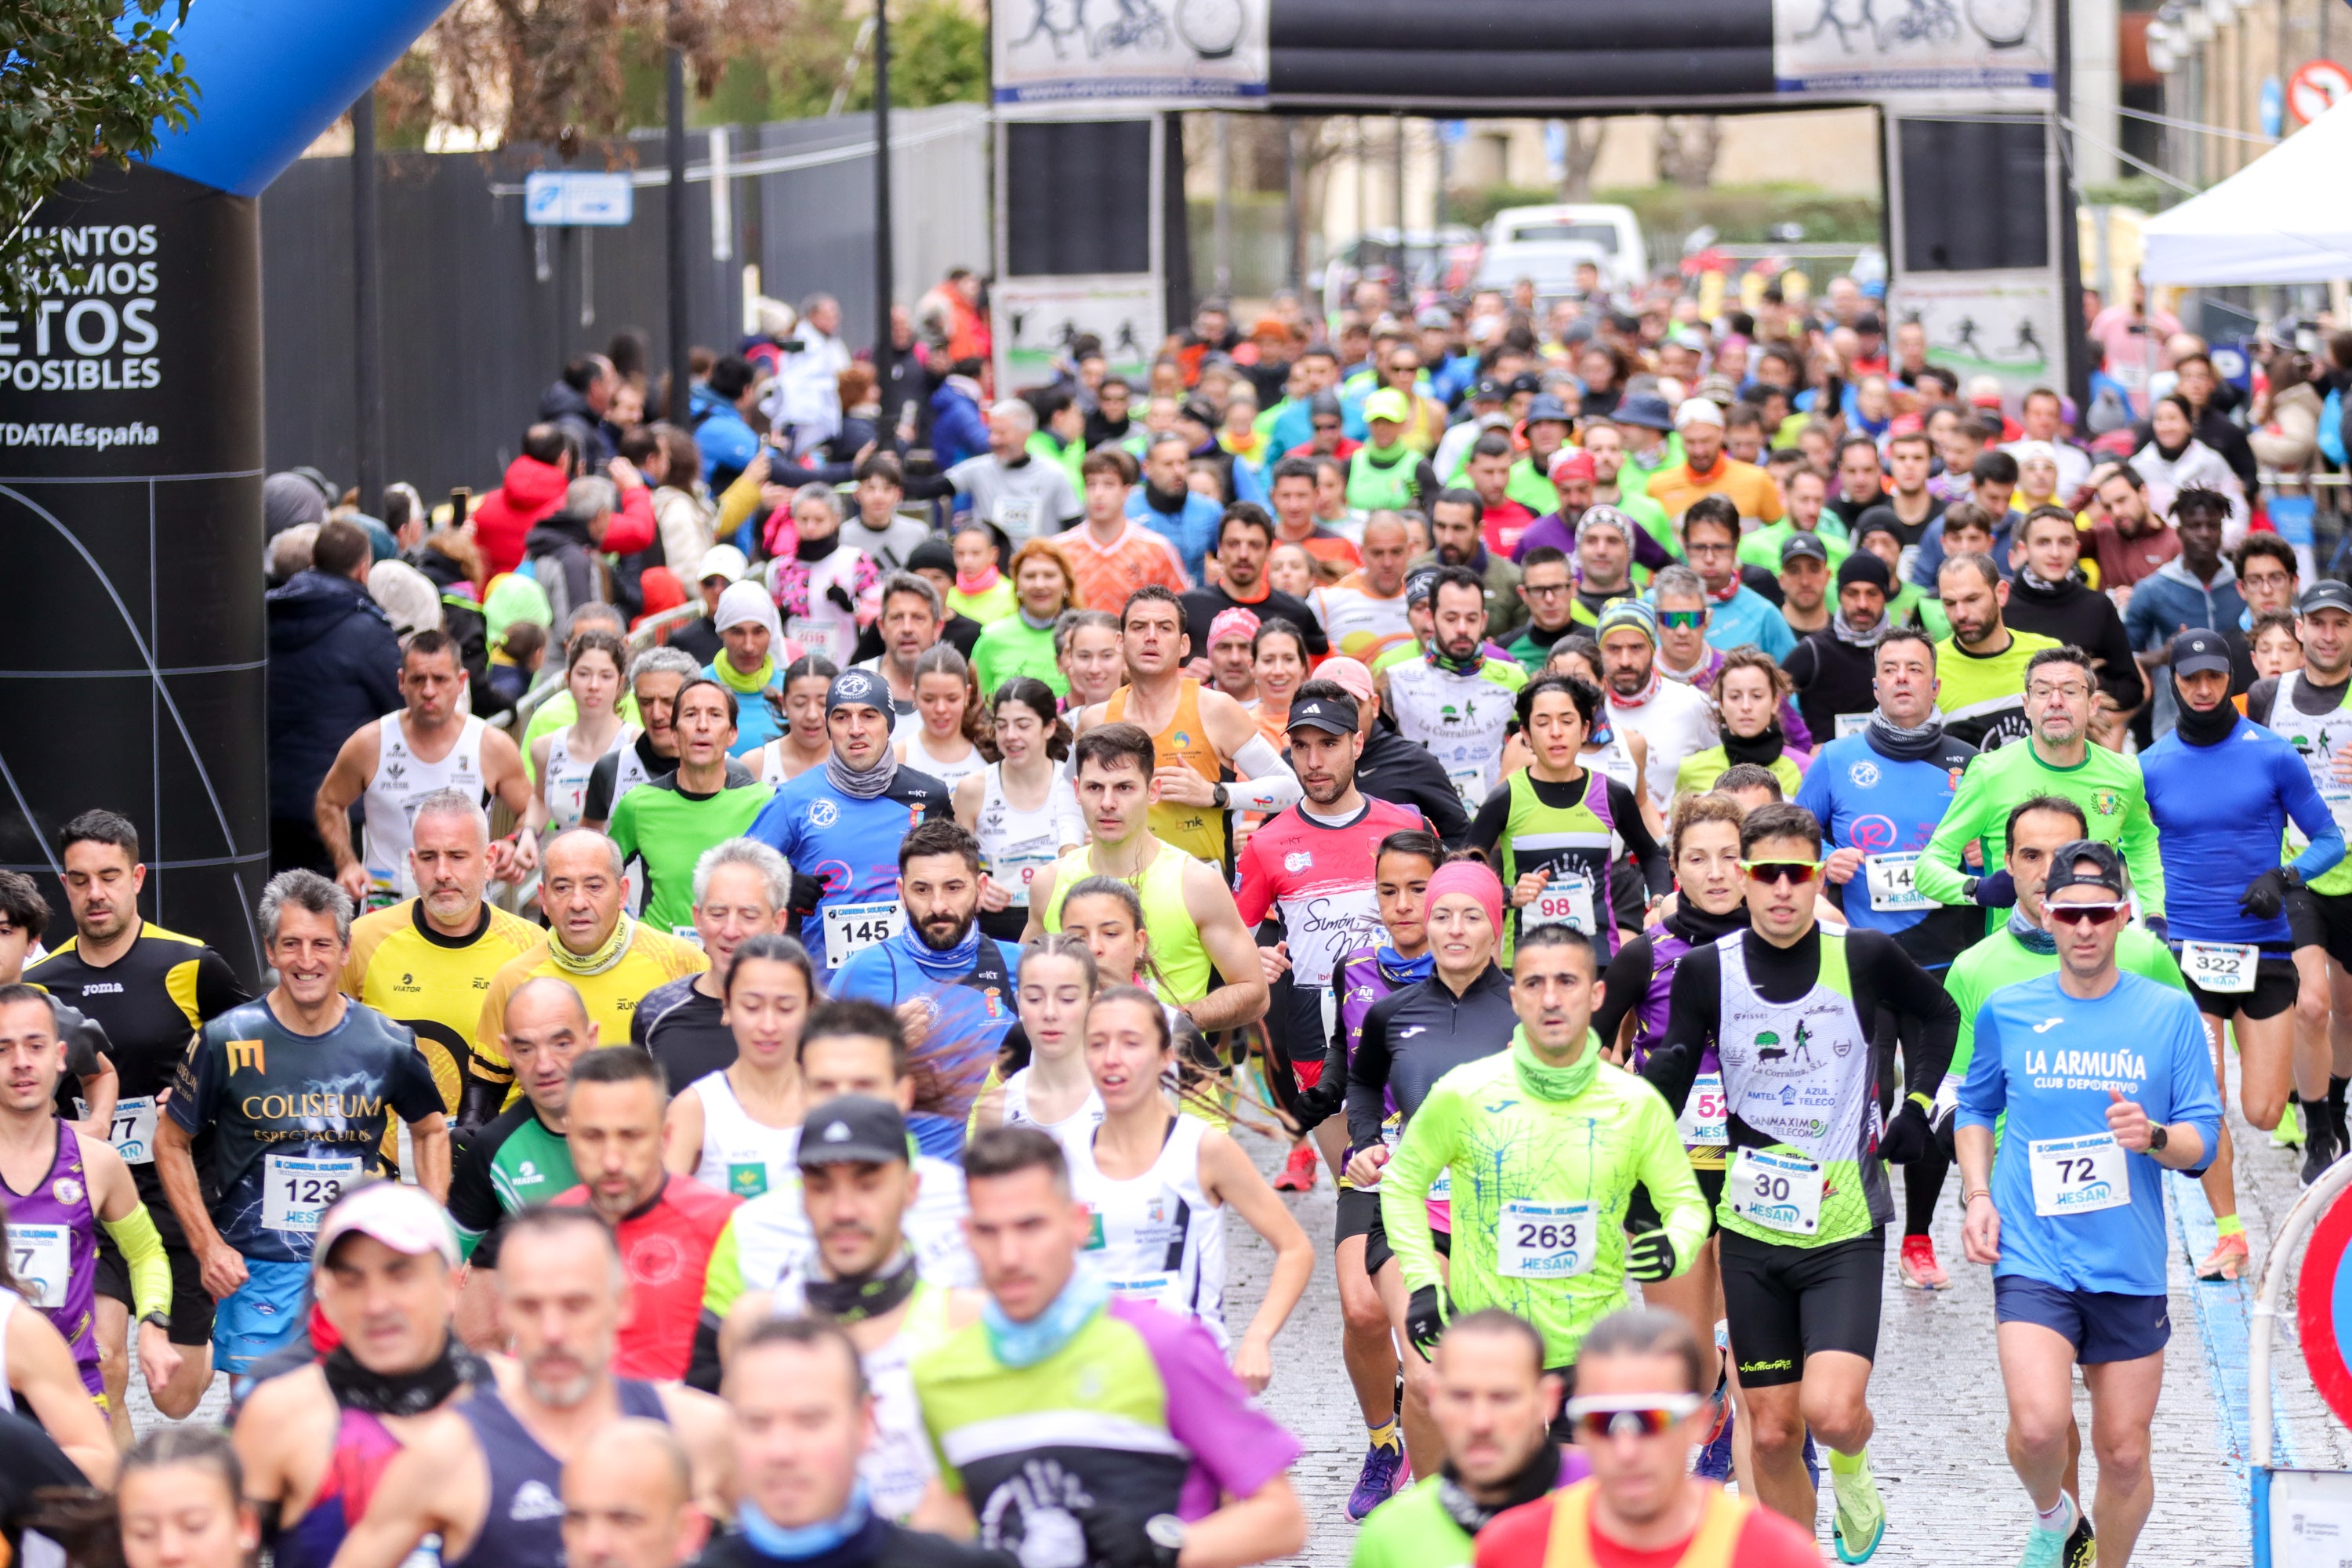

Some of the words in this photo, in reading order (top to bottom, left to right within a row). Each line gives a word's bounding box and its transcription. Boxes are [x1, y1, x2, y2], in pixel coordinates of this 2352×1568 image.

[1541, 898, 1570, 916] 98
[841, 920, 889, 942] 145
[2196, 956, 2240, 974] 322
[393, 984, 421, 993] VIATOR
[1751, 1063, 1763, 1074] La
[1764, 1066, 1809, 1078] Corralina,
[2025, 1050, 2047, 1075] LA
[2053, 1048, 2147, 1080] ARMUÑA
[2034, 1077, 2063, 1089] CLUB
[2067, 1078, 2139, 1094] DEPORTIVO
[241, 1094, 383, 1120] COLISEUM
[1748, 1091, 1777, 1101] AMTEL
[1798, 1098, 1835, 1106] TELECO
[1773, 1126, 1814, 1138] TELECOM
[2056, 1157, 2096, 1185] 72
[285, 1178, 340, 1204] 123
[1755, 1174, 1790, 1201] 30
[2057, 1187, 2107, 1205] HESAN
[1748, 1202, 1795, 1224] HESAN
[1517, 1223, 1577, 1249] 263
[1521, 1257, 1573, 1270] HESAN
